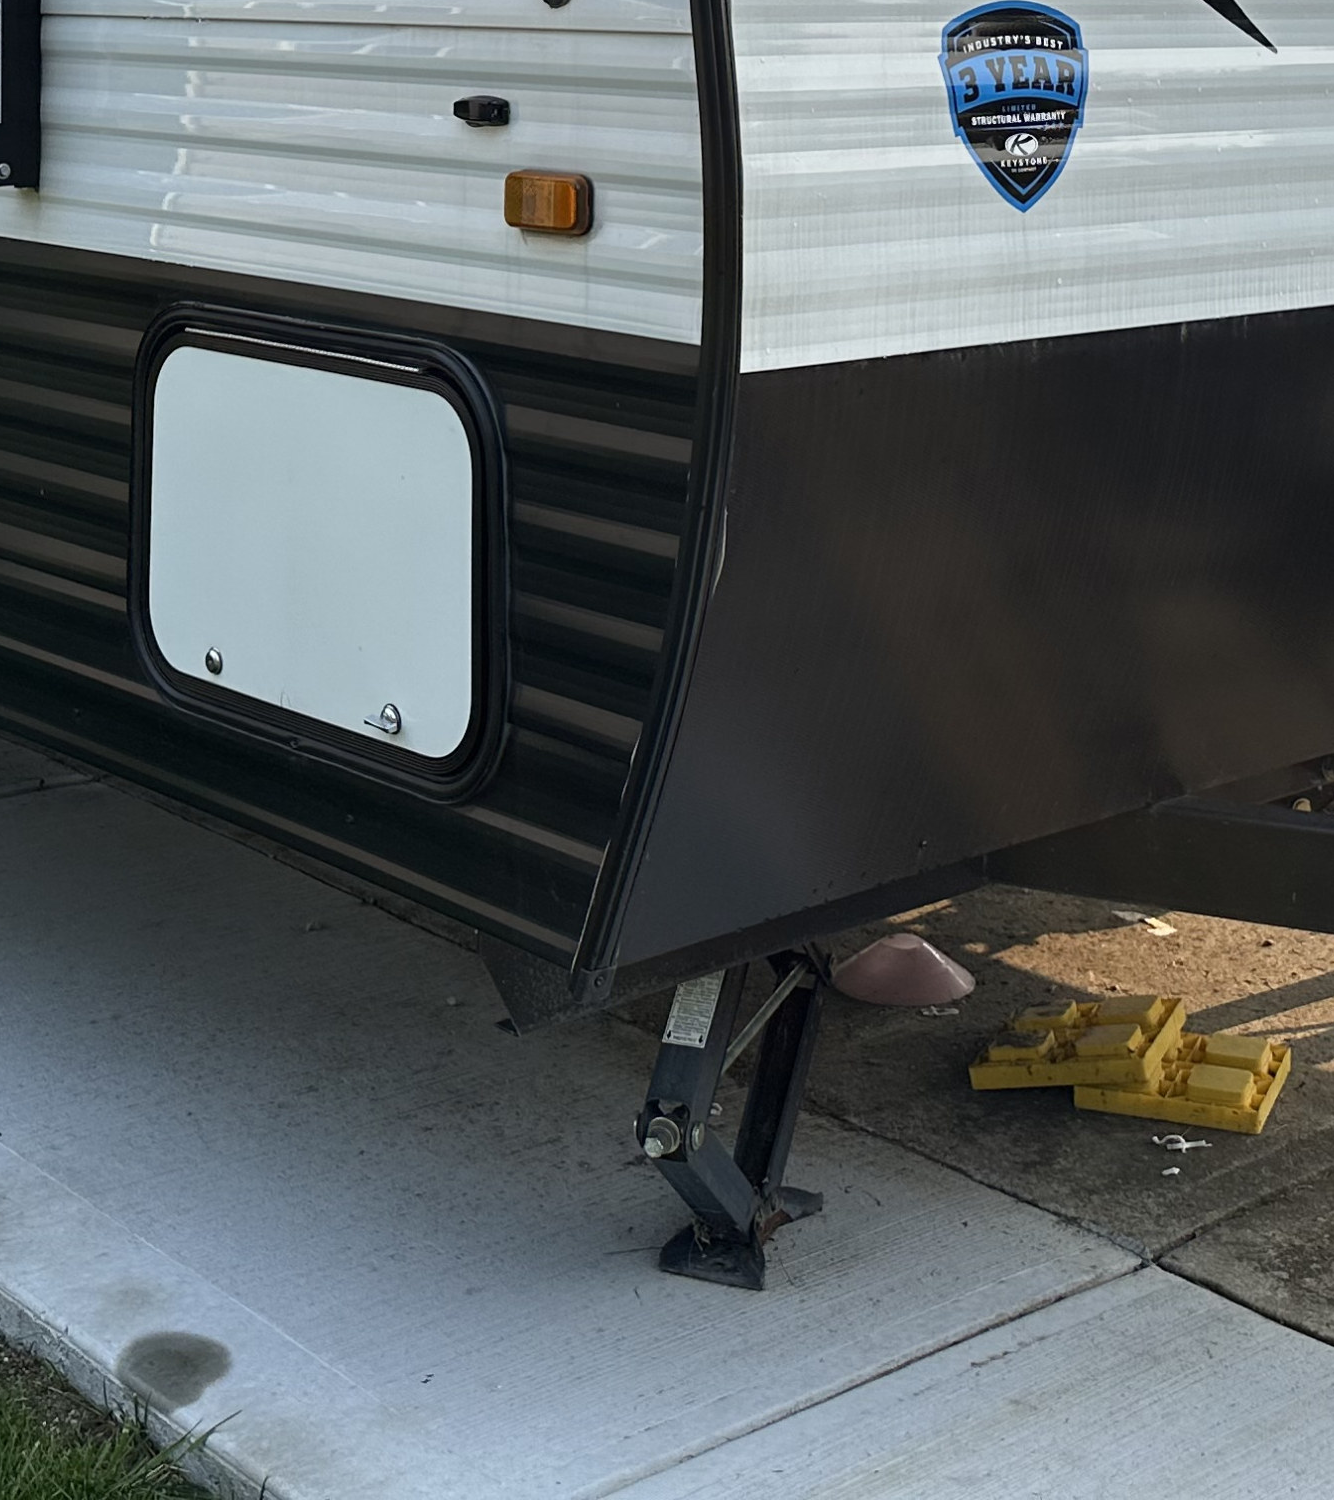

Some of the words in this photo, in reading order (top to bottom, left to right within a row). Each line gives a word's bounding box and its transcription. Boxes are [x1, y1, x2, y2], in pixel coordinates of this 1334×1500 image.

[963, 35, 1031, 54] INDUSTRY'S
[1036, 36, 1064, 50] BEST
[958, 67, 980, 103] 3
[986, 55, 1075, 96] YEAR
[1002, 104, 1037, 112] LIMITED
[971, 113, 1023, 126] STRUCTURAL
[1023, 111, 1066, 123] WARRANTY
[1000, 156, 1048, 168] KEYSTONE
